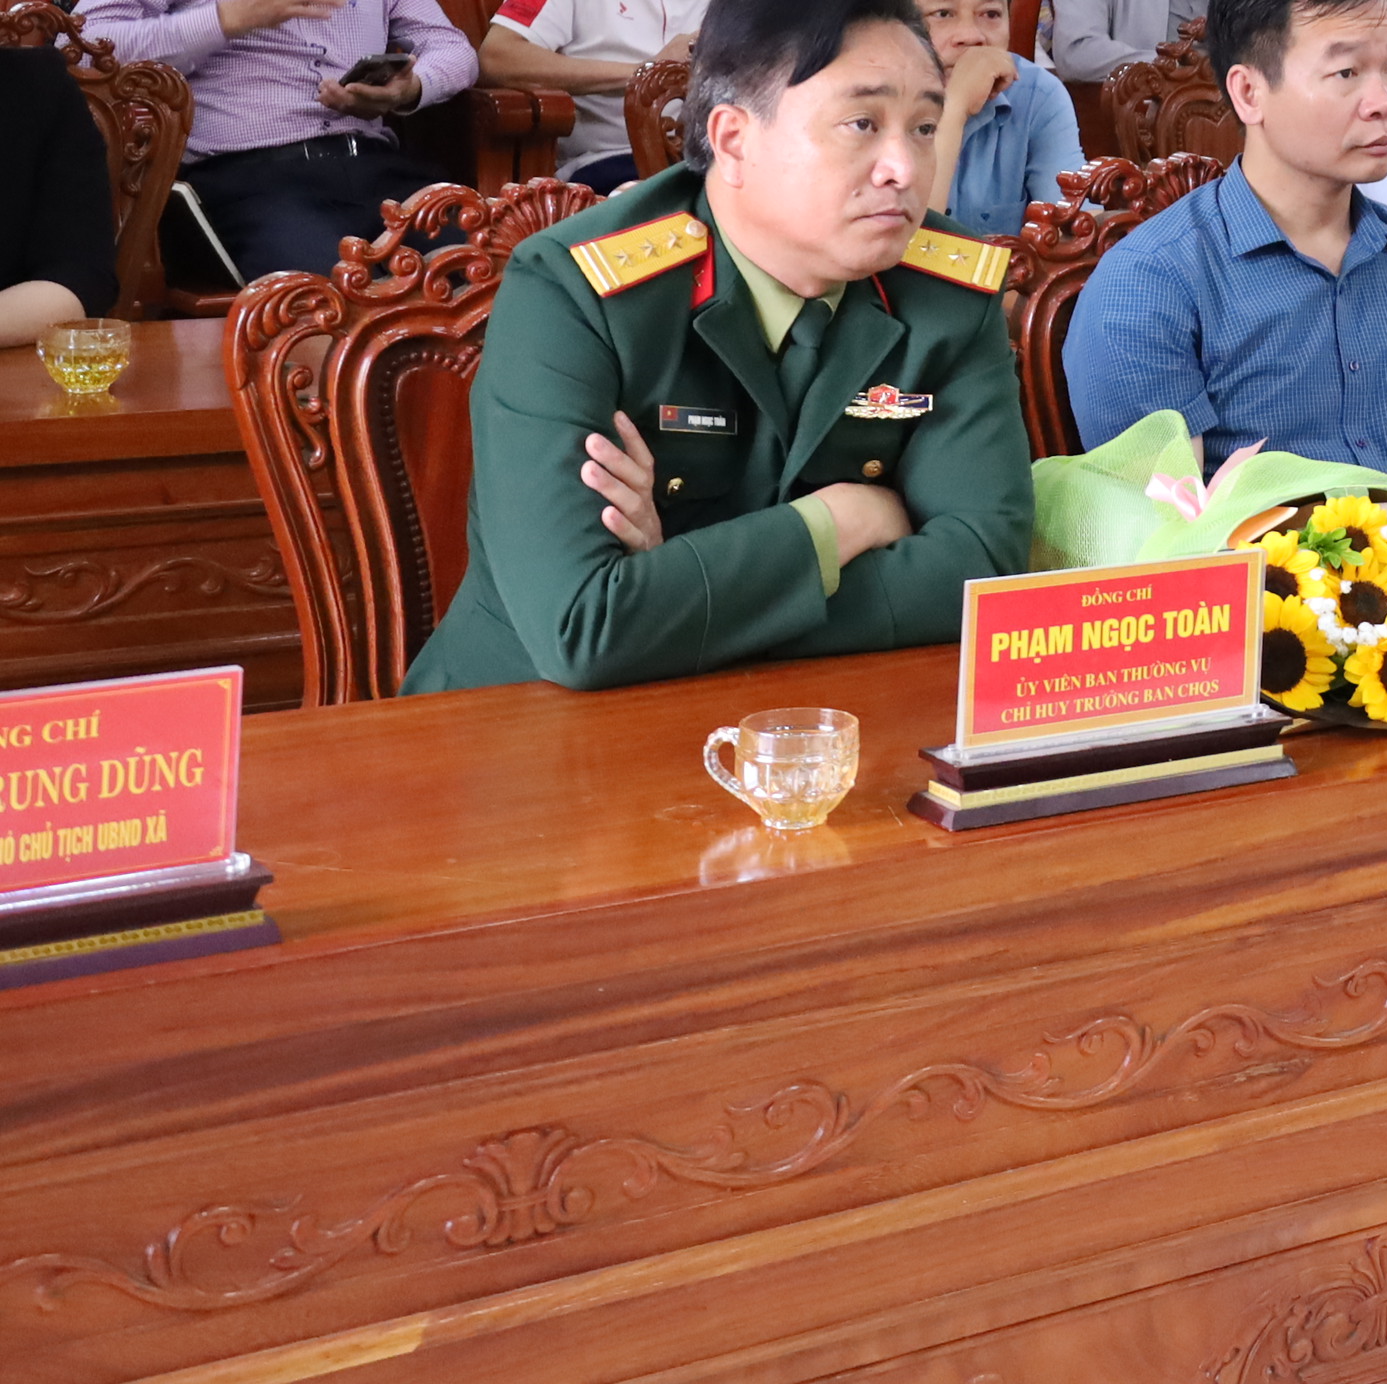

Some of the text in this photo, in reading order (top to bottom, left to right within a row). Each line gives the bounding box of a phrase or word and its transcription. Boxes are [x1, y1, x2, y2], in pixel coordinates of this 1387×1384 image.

[1081, 584, 1153, 607] ĐỒNG CHÍ
[990, 601, 1231, 663] PHẠM NGỌC TOÀN
[1016, 657, 1212, 698] ỦY VIÊN BAN THƯỜNG VỤ
[1001, 679, 1220, 724] CHỈ HUY TRƯỞNG BAN CHQS
[42, 709, 101, 744] CHÍ
[0, 746, 205, 813] UNG DŨNG
[19, 821, 54, 863] CHỦ
[57, 824, 94, 864] TỊCH
[97, 817, 143, 852] UBND
[145, 809, 168, 845] XÃ
